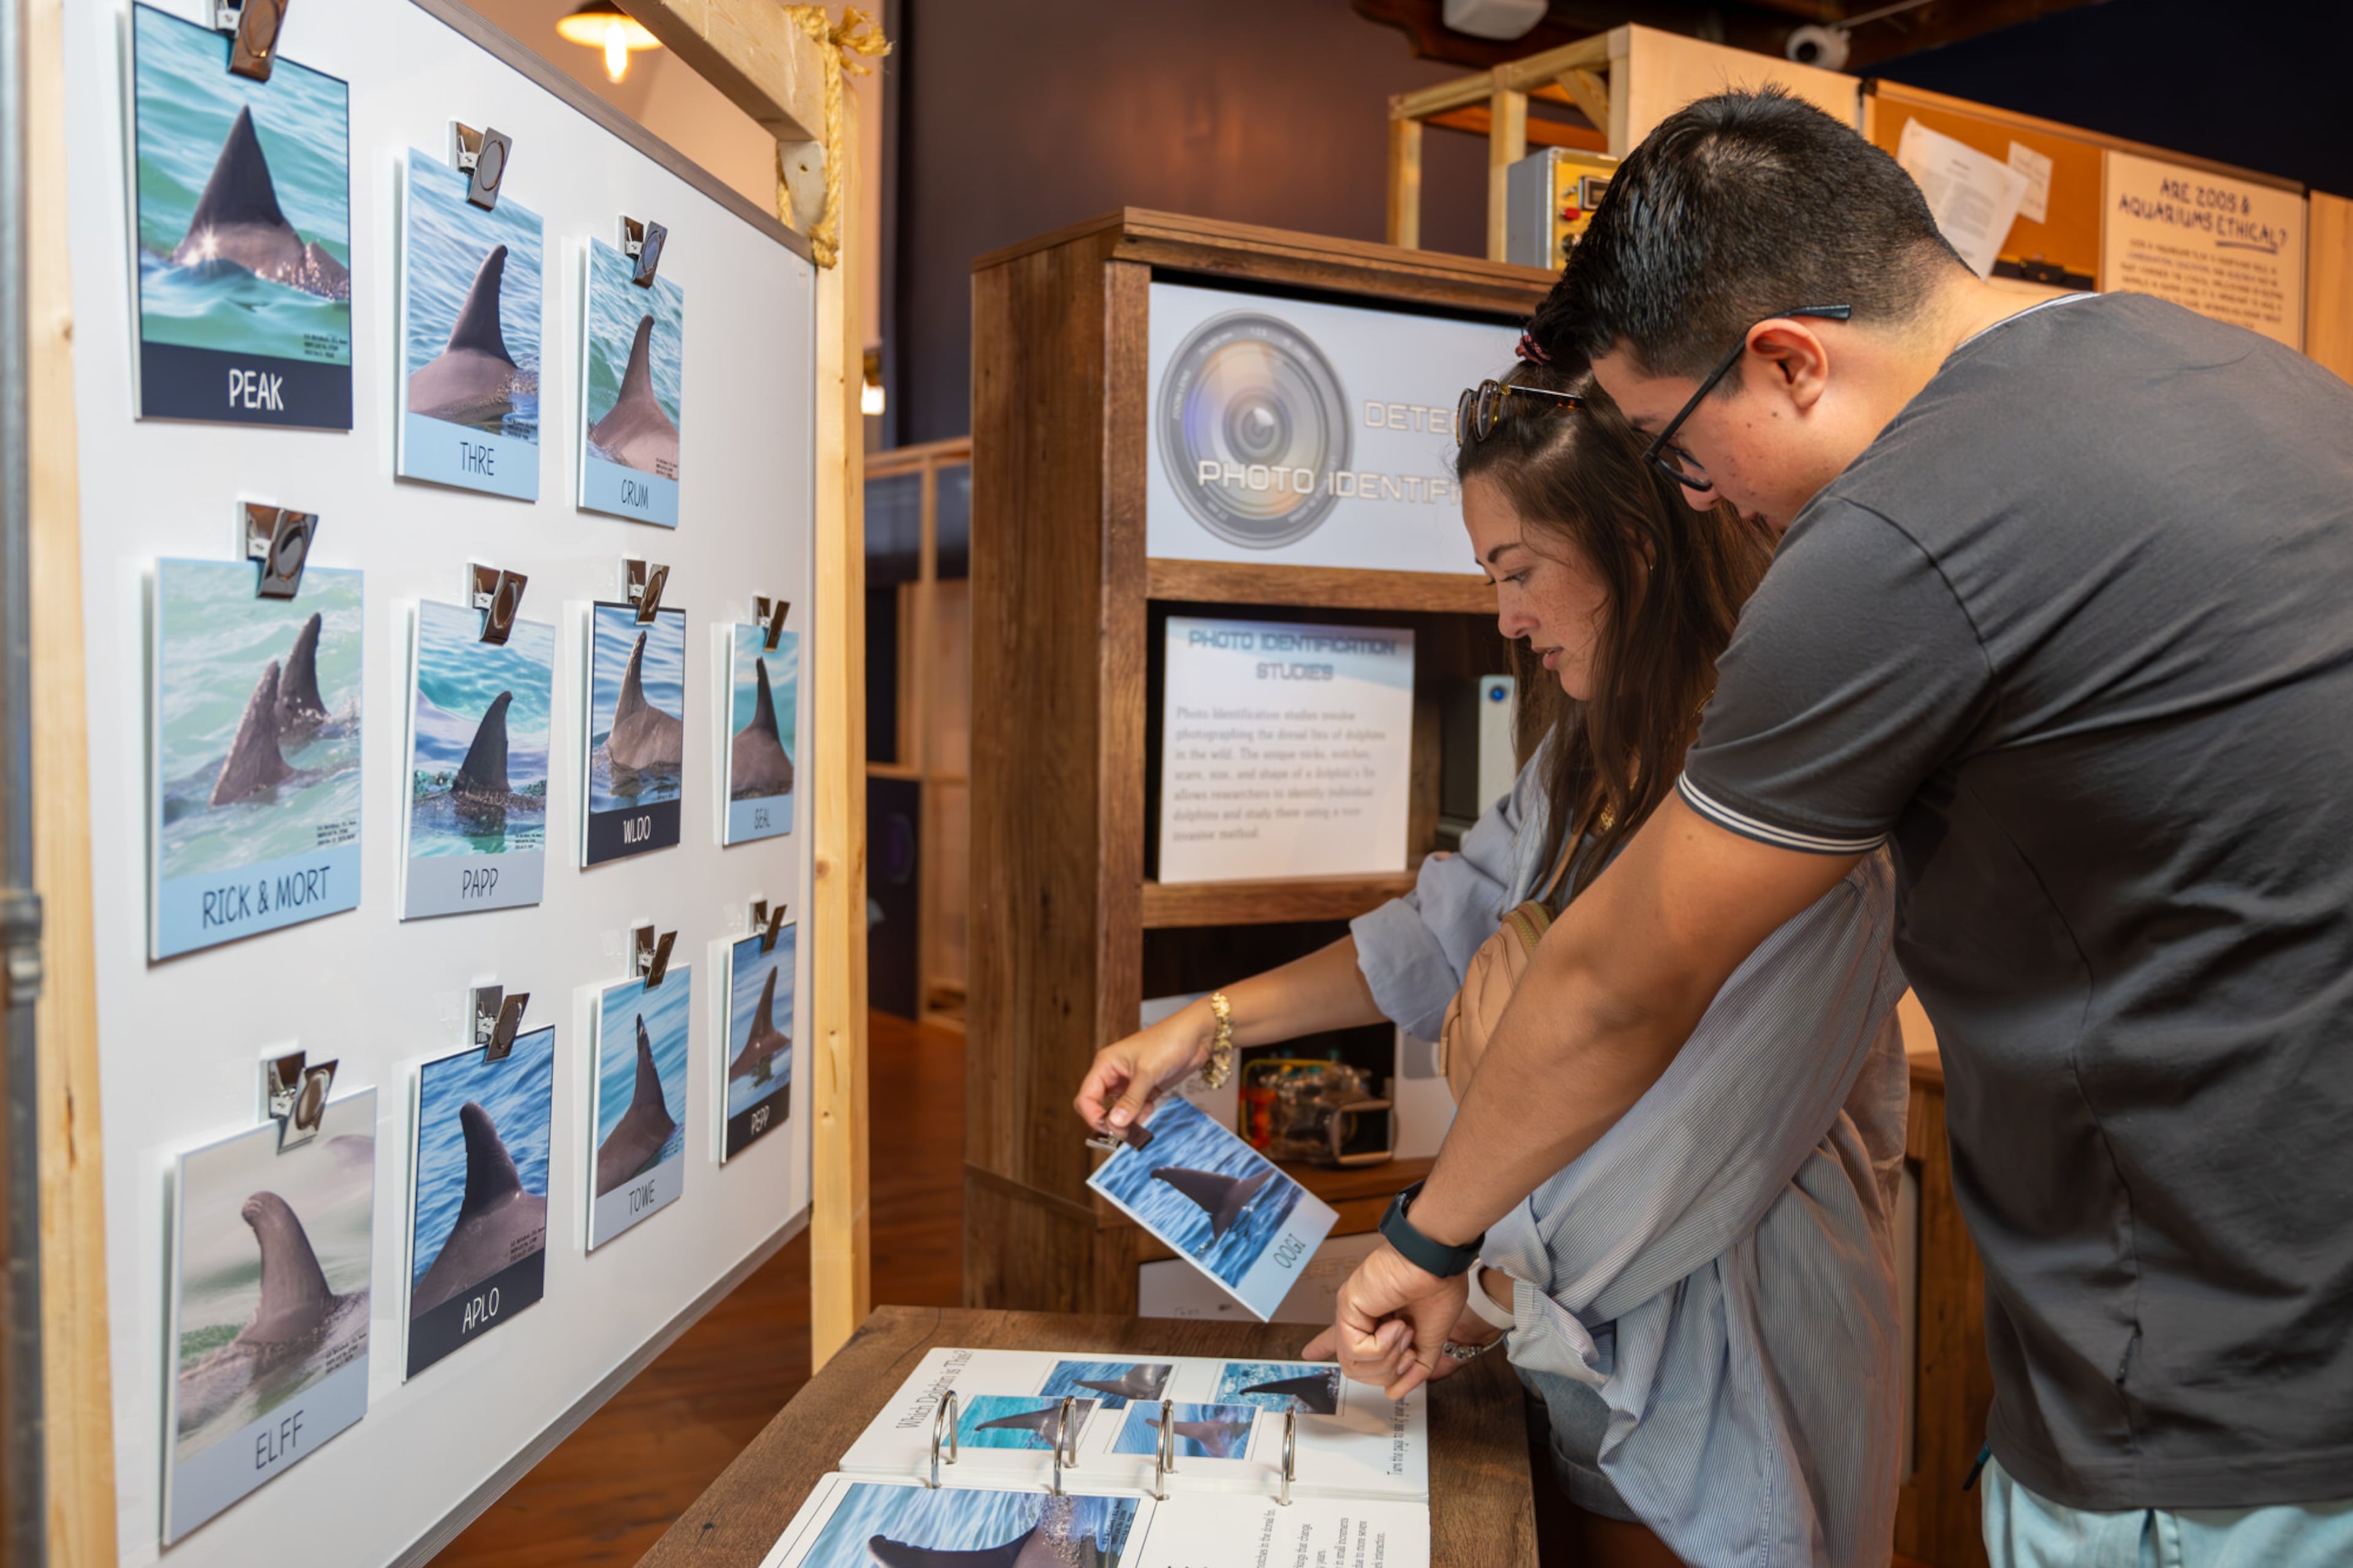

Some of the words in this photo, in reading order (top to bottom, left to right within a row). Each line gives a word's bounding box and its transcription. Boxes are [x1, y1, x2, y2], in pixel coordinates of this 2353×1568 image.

[2159, 178, 2191, 204] ARE
[2118, 193, 2214, 232] AQUARIUMS
[229, 368, 284, 411] PEAK
[460, 441, 494, 476] THRE
[621, 479, 648, 509] CRUM
[1197, 460, 1315, 494] PHOTO
[1327, 469, 1462, 506] IDENTIFI
[1189, 629, 1254, 651] PHOTO
[1256, 662, 1334, 681] STUDIES
[623, 815, 651, 844] WLDO
[202, 885, 251, 930] RICK
[257, 879, 269, 915] &
[275, 865, 330, 911] MORT
[462, 868, 499, 900] PAPP
[628, 1179, 655, 1216] TOWE
[1273, 1232, 1306, 1269] OOGI
[462, 1287, 500, 1335] APLO
[895, 1404, 934, 1429] Which
[915, 1376, 957, 1404] Dolphin
[255, 1409, 305, 1470] ELFF
